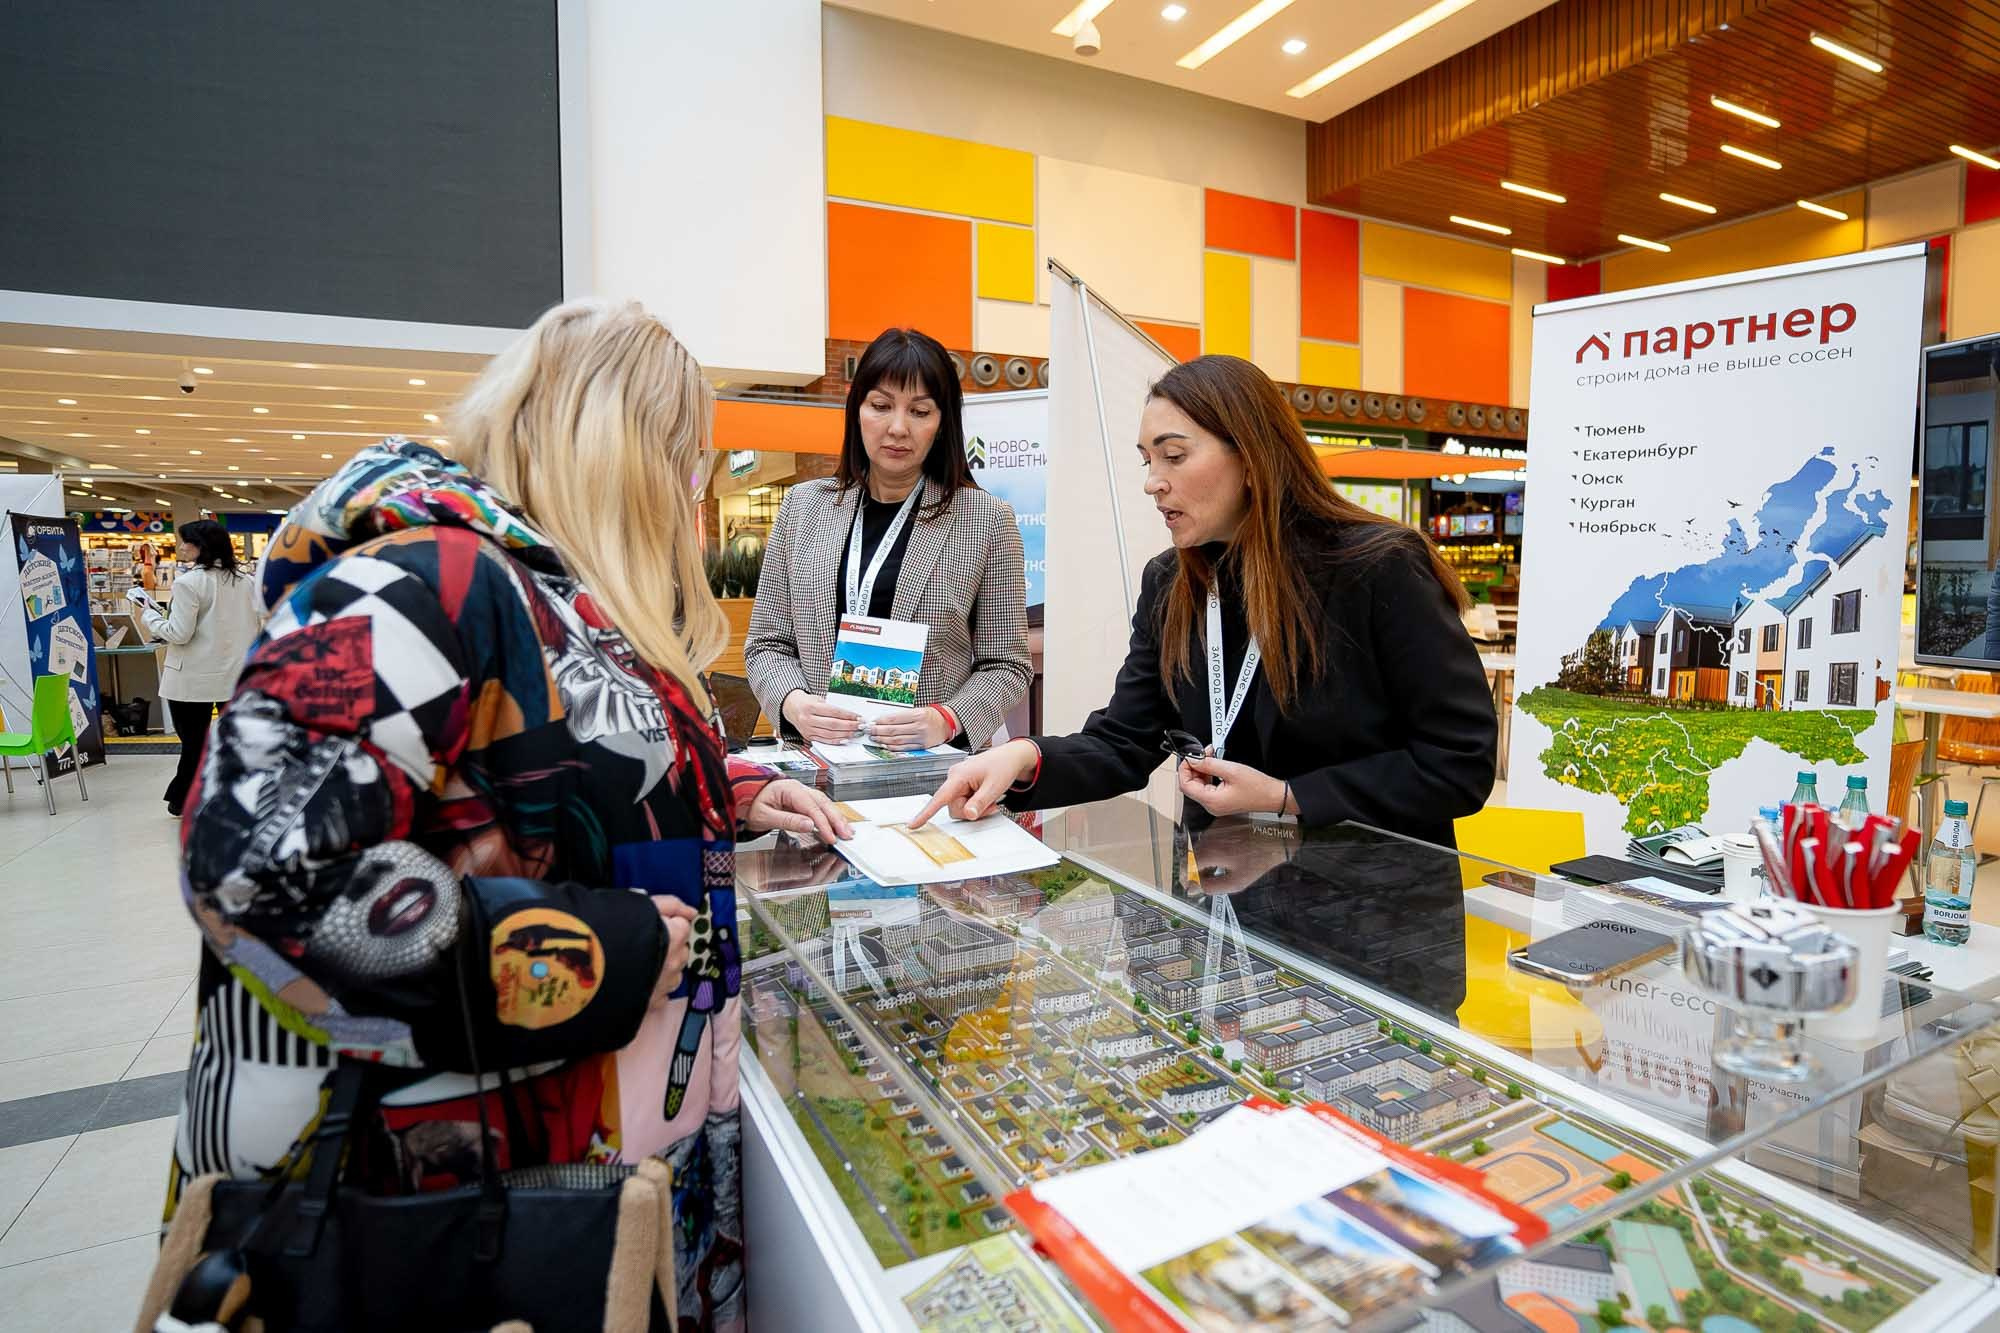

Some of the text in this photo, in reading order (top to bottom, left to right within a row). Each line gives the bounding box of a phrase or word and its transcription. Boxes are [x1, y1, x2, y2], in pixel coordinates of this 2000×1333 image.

[1624, 303, 1857, 360] партнер
[1576, 346, 1853, 388] строим дома не выше сосен
[1584, 424, 1645, 437] Тюмень
[1583, 443, 1698, 461] Екатеринбург
[1582, 473, 1624, 485] Омск
[1580, 497, 1635, 511] Курган
[36, 525, 65, 535] ОРБИТА
[1580, 519, 1656, 535] Ноябрьск
[1239, 653, 1256, 690] ЭКСПО
[1211, 646, 1223, 735] ЗАГОРОД ЭКСПО
[1252, 825, 1295, 840] УЧАСТНИК
[1951, 820, 1961, 848] BORJOMI
[1933, 909, 1967, 920] BORJOMI
[1768, 1085, 1810, 1103] участия
